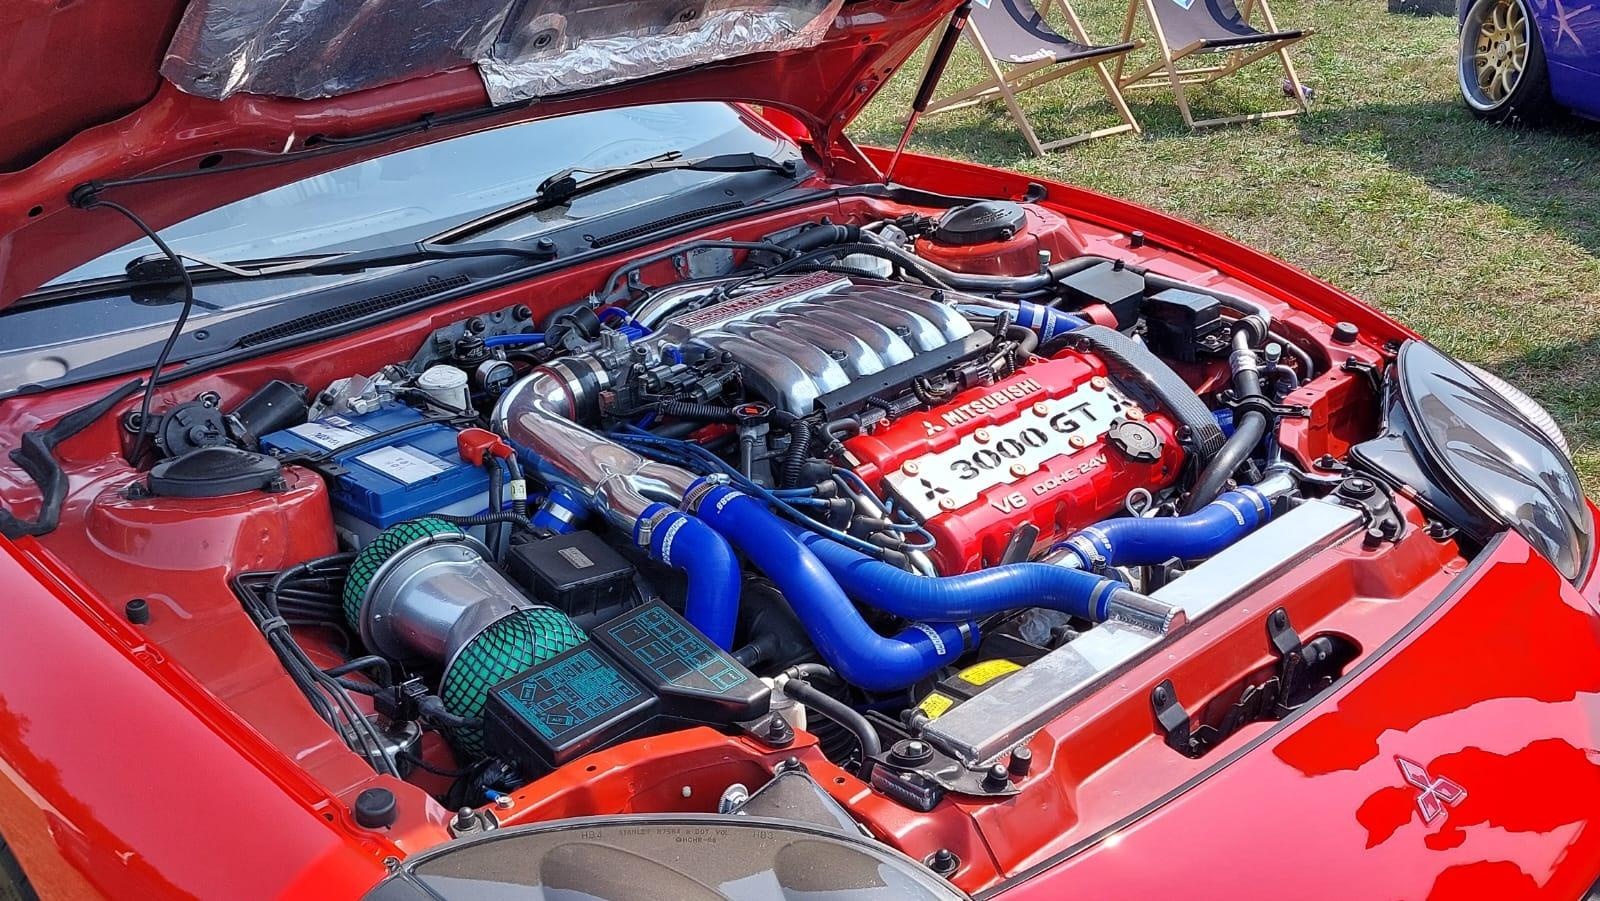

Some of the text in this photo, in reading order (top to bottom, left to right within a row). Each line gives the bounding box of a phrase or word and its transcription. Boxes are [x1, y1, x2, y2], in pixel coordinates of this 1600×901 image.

[942, 379, 1041, 427] MITSUBISHI
[950, 402, 1098, 480] 3000 GT
[991, 490, 1028, 515] V6
[1079, 453, 1108, 476] 24V
